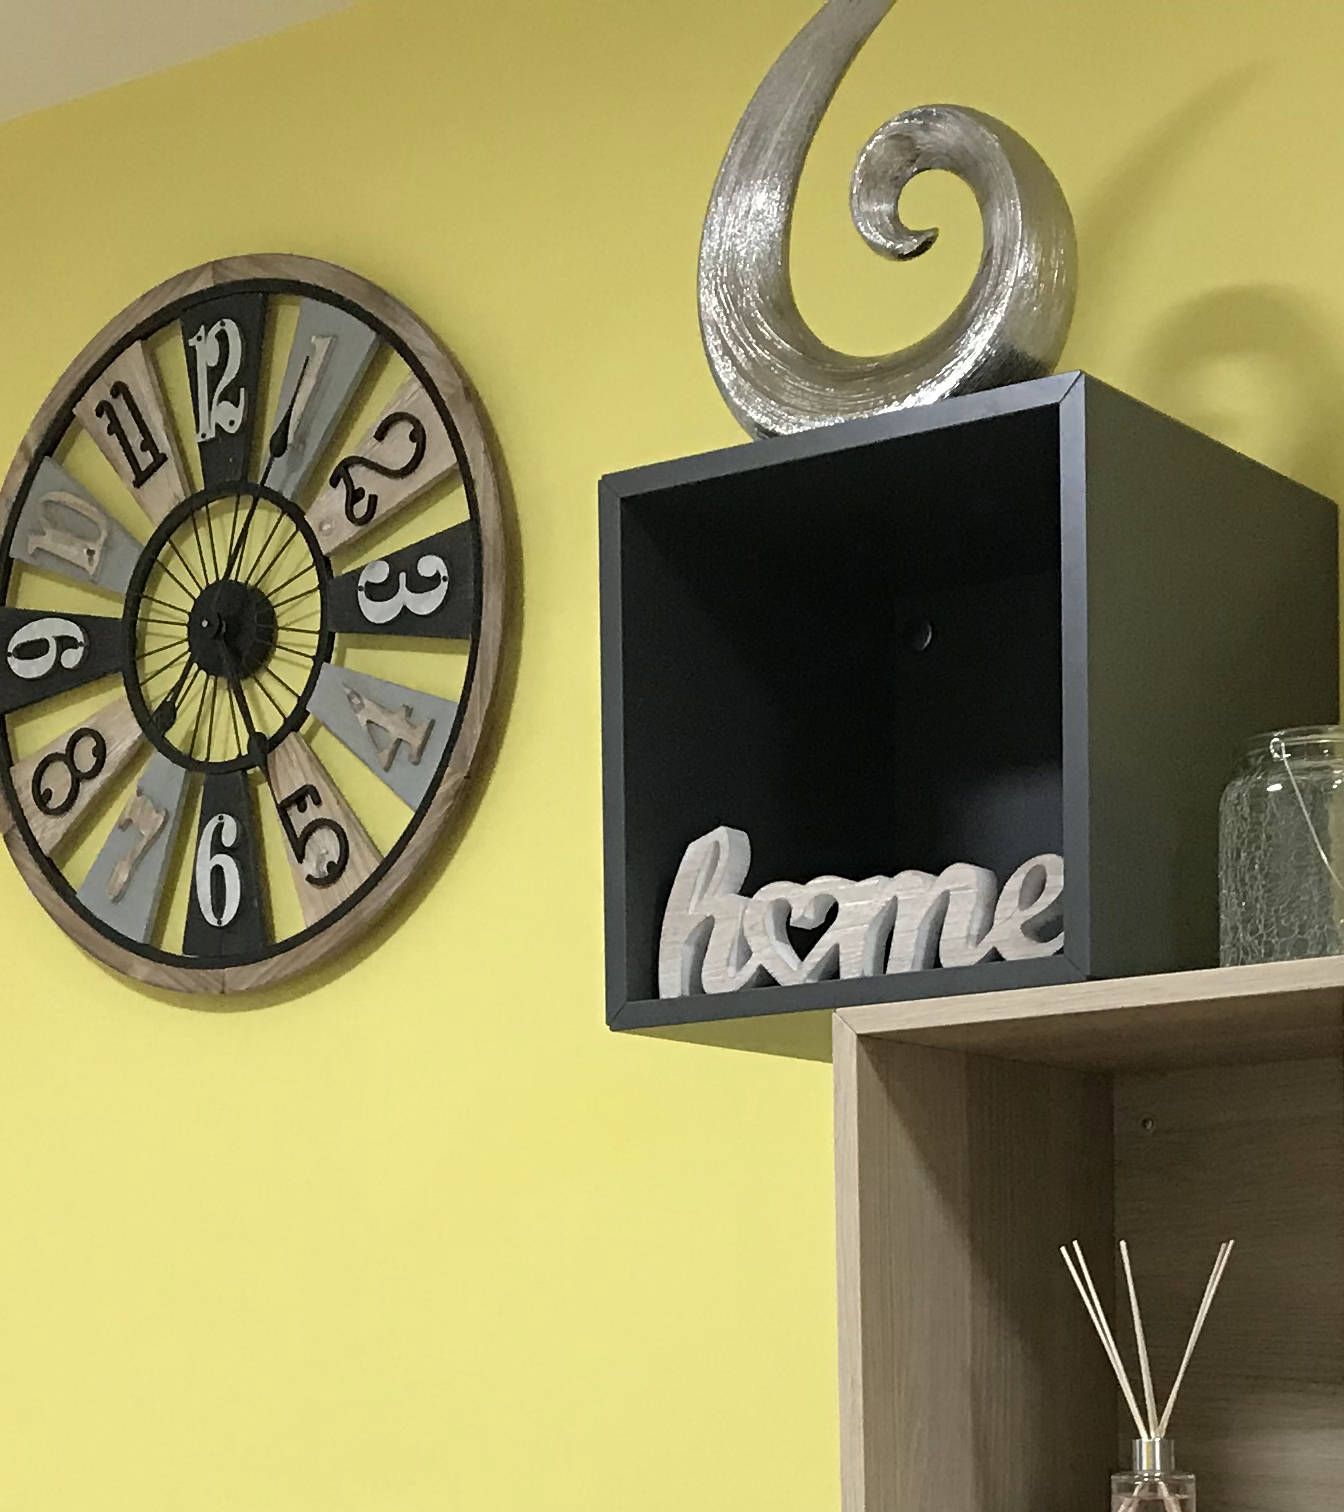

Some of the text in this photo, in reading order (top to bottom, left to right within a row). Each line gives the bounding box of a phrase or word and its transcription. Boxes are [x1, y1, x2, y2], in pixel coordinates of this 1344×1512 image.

[94, 380, 168, 489] 11
[188, 318, 245, 443] 12
[281, 335, 336, 446] 1
[329, 411, 426, 526] 2
[357, 554, 449, 624] 3
[7, 617, 85, 679] 9
[32, 728, 106, 815] 8
[344, 682, 436, 772] 4
[106, 788, 168, 903] 7
[196, 813, 241, 927] 6
[279, 784, 349, 889] 5
[658, 825, 1064, 1000] home
